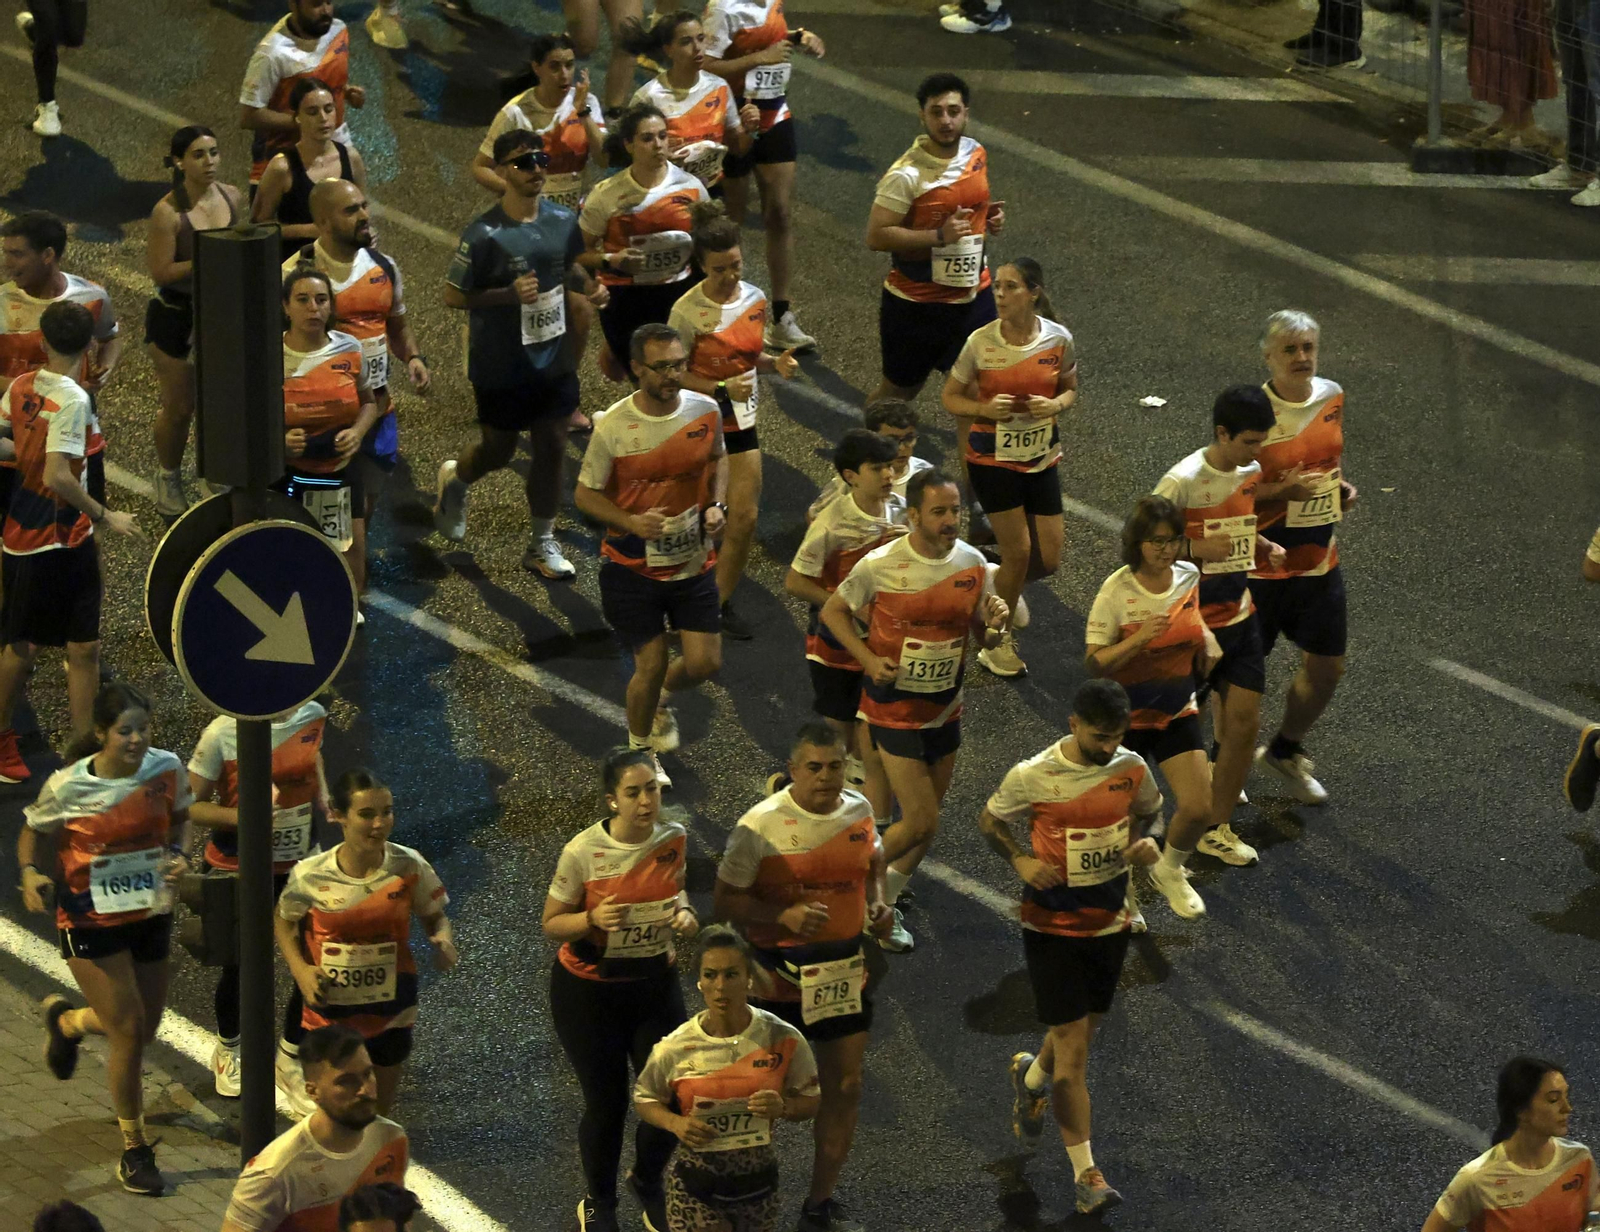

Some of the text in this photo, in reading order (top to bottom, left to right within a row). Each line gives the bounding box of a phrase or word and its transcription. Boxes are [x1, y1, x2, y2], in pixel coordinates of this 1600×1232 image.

[943, 257, 977, 273] 7556
[1002, 429, 1046, 448] 21677
[907, 659, 954, 678] 13122
[1080, 846, 1120, 869] 8045
[99, 872, 154, 896] 16929
[329, 967, 386, 988] 23969
[813, 981, 849, 1006] 6719
